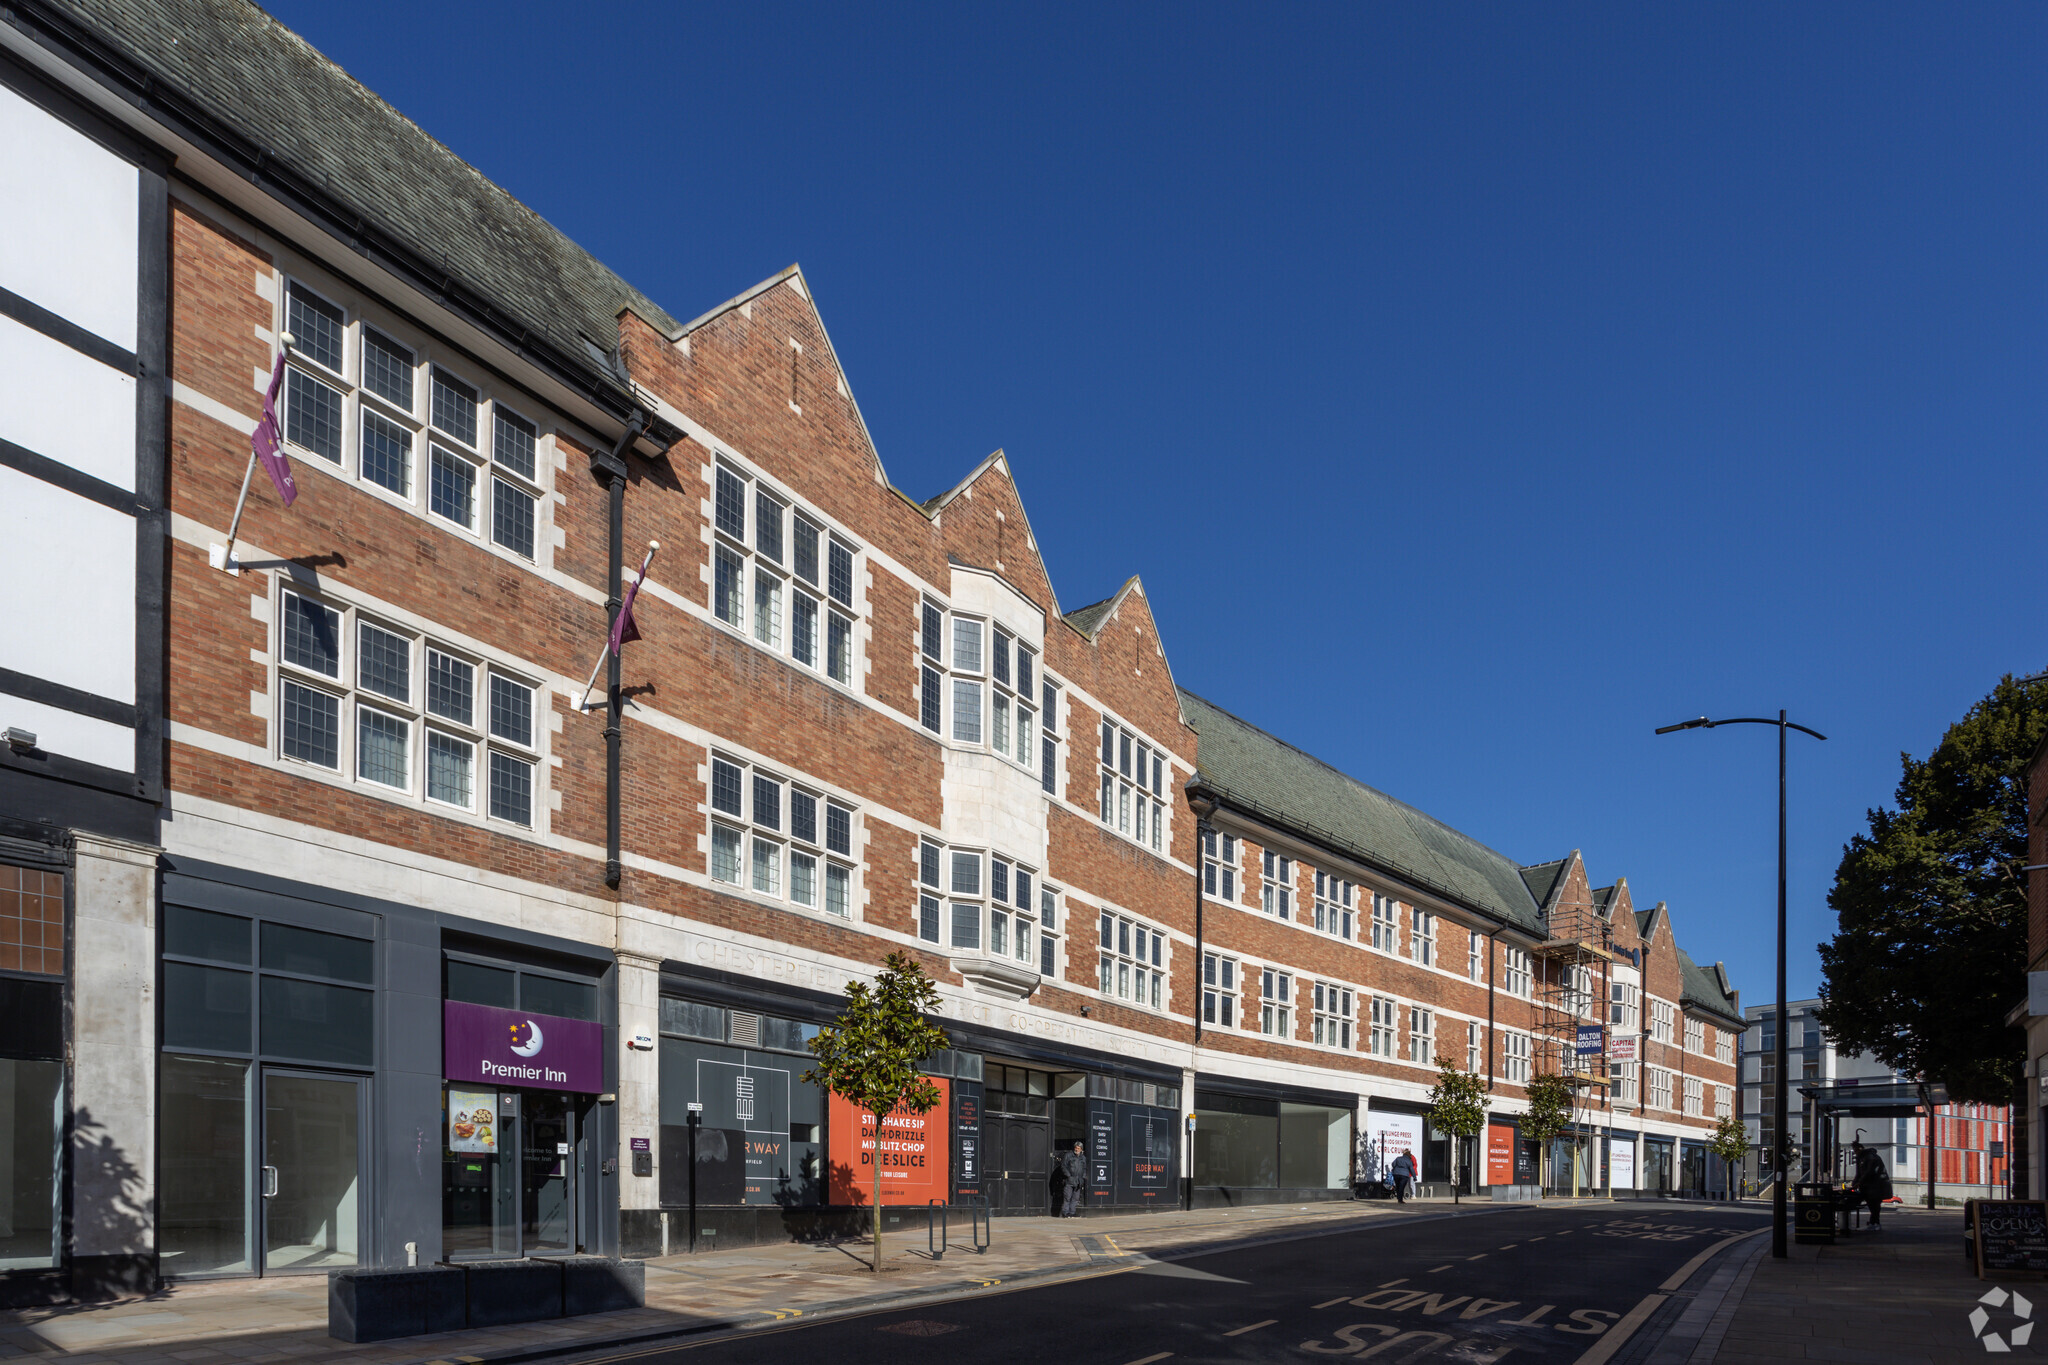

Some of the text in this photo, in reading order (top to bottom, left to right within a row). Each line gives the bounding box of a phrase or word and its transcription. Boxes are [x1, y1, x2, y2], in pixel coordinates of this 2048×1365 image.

[1578, 1032, 1601, 1041] DALTON
[1577, 1040, 1602, 1049] ROOFING
[1611, 1039, 1635, 1047] CAPITAL
[482, 1059, 567, 1083] Premier Inn
[754, 1142, 781, 1155] WAY
[1136, 1163, 1165, 1174] ELDER WAY
[893, 1171, 908, 1179] LEISURE
[1604, 1221, 1749, 1236] STAND
[1990, 1217, 2028, 1231] OPEN
[1592, 1229, 1694, 1241] BUS
[1347, 1289, 1621, 1335] STAND
